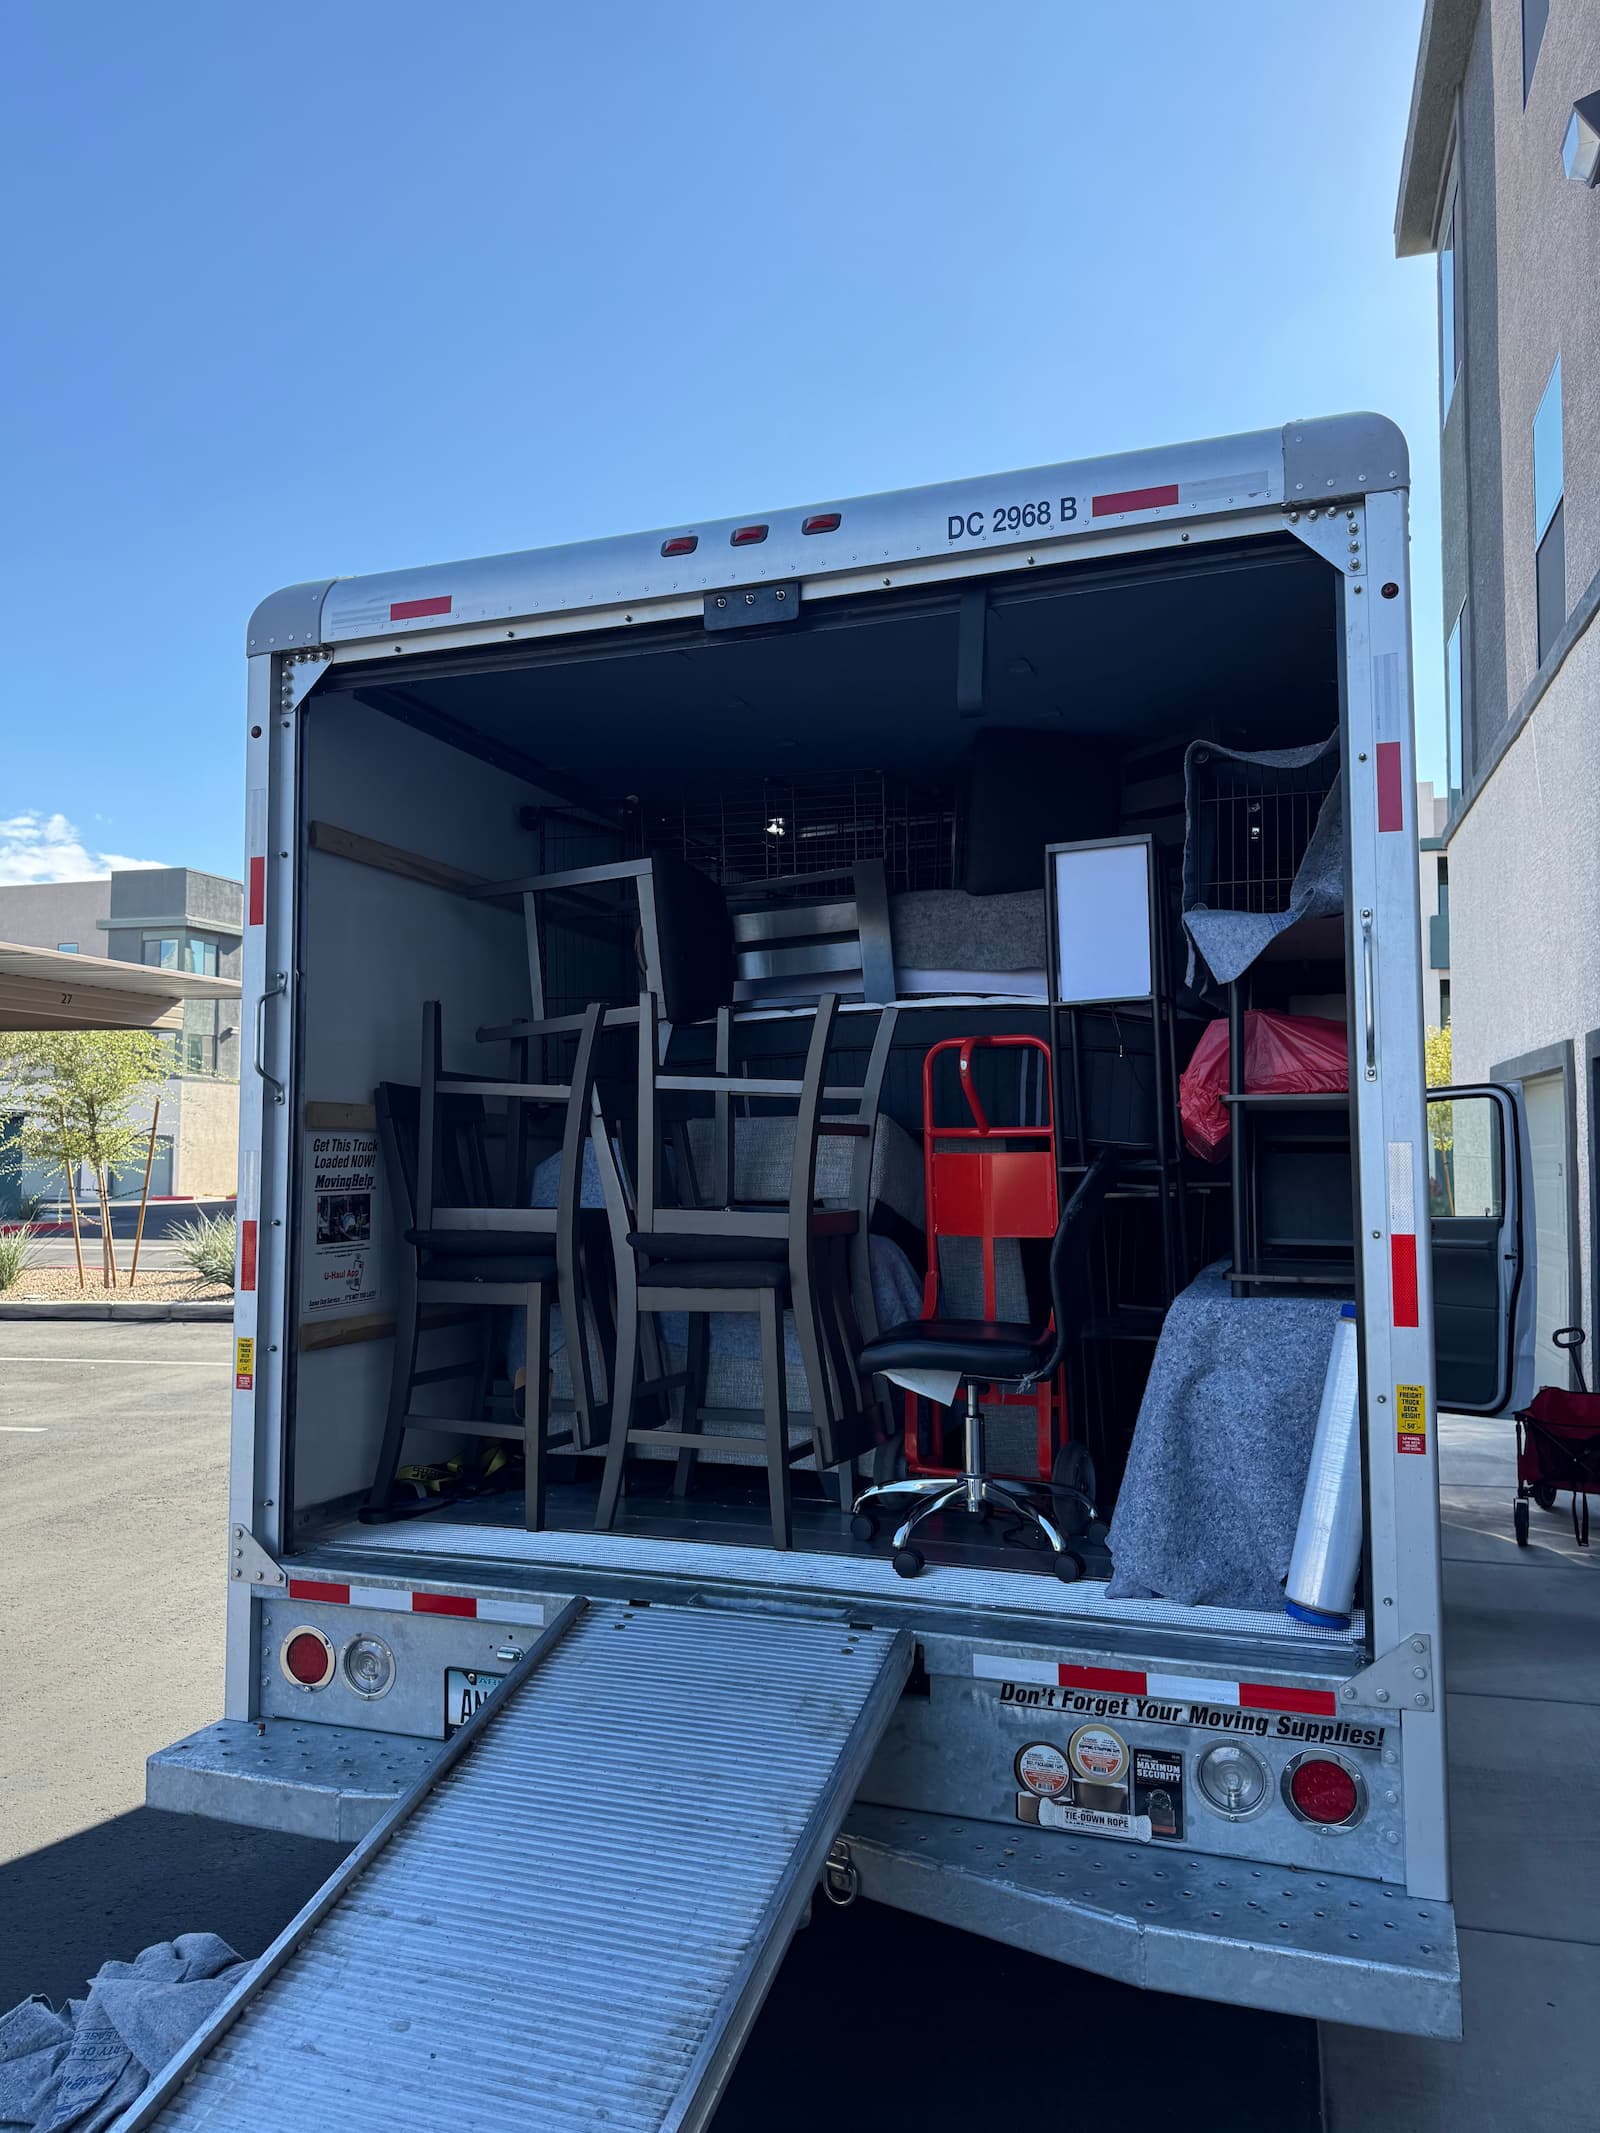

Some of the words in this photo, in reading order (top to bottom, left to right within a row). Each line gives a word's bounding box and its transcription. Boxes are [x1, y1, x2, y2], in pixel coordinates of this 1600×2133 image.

[948, 511, 984, 540] DC
[992, 501, 1051, 533] 2968
[1060, 497, 1077, 522] B
[60, 992, 73, 1004] 27
[313, 1138, 330, 1152] Get
[331, 1138, 351, 1152] This
[353, 1138, 378, 1152] Truck
[314, 1155, 350, 1169] Loaded
[350, 1154, 376, 1168] NOW!
[315, 1173, 374, 1191] MovingHelp
[324, 1270, 345, 1280] U-Haul
[1000, 1682, 1056, 1707] Don't
[1061, 1690, 1129, 1717] Forget
[1136, 1700, 1182, 1722] Your
[1188, 1705, 1269, 1736] Moving
[1276, 1715, 1386, 1747] Supplies!
[1136, 1761, 1181, 1774] MAXIMUM
[1136, 1769, 1181, 1782] SECURITY
[1064, 1810, 1106, 1825] TIE-DOWN
[1107, 1816, 1129, 1829] ROPE
